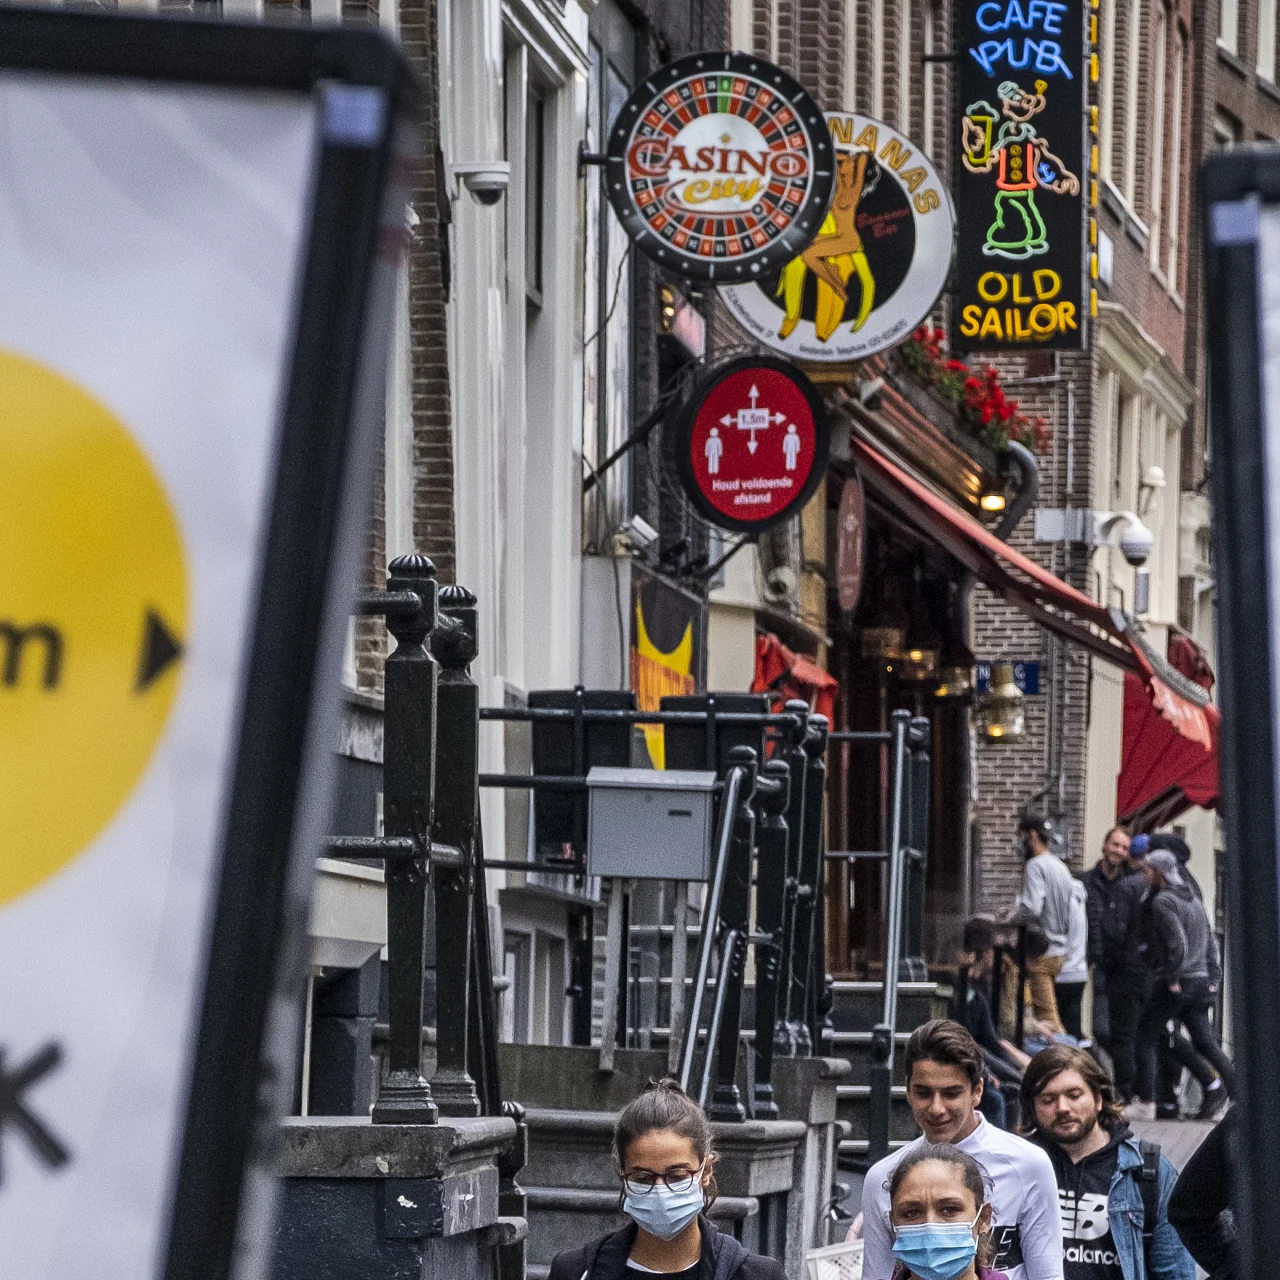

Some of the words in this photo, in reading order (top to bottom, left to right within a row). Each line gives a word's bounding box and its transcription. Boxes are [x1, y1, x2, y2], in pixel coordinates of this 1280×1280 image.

[975, 0, 1069, 33] CAFE
[968, 37, 1074, 79] PUB
[827, 117, 941, 215] NANAS
[682, 177, 762, 205] City
[977, 268, 1063, 304] OLD
[959, 301, 1078, 342] SAILOR
[1062, 1244, 1122, 1266] alanc
